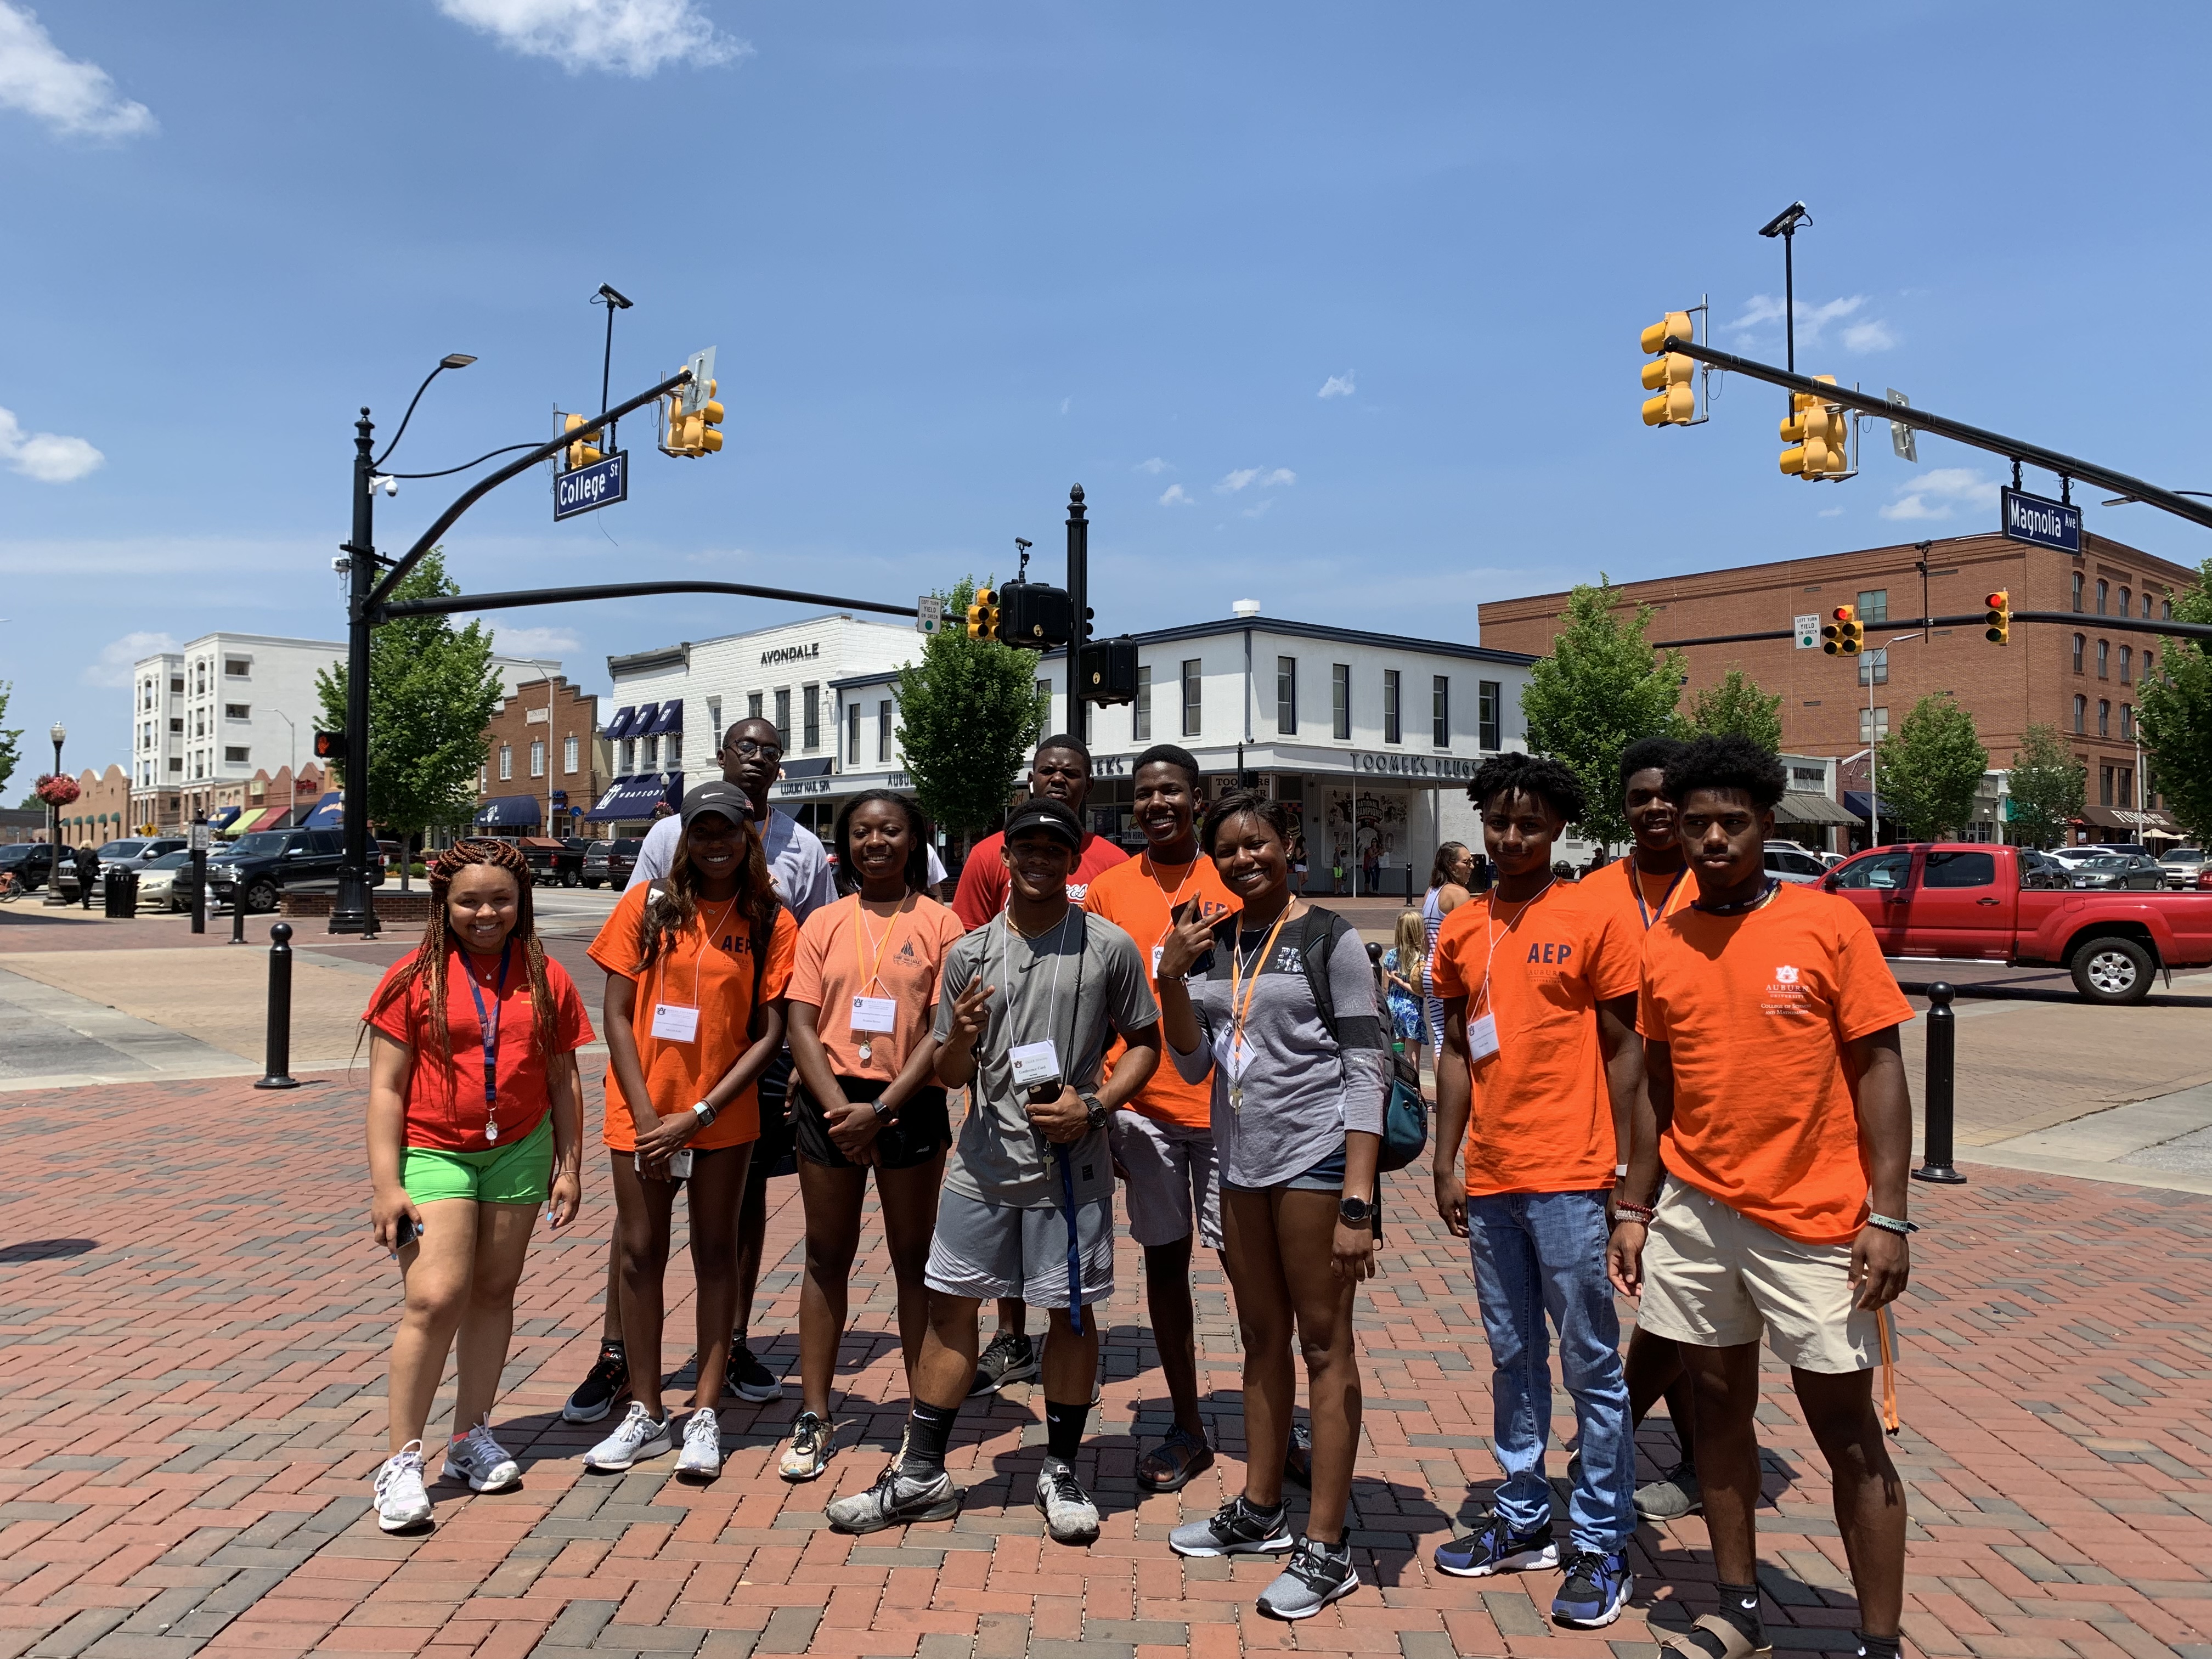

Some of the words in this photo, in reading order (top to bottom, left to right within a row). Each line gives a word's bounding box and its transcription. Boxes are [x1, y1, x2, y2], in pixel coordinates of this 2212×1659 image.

[560, 472, 605, 505] College
[610, 463, 618, 478] St
[2011, 498, 2061, 538] Magnolia
[2064, 513, 2076, 529] Ave
[760, 642, 819, 664] AVONDALE
[1350, 753, 1427, 773] TOOMER'S
[781, 782, 803, 795] LUXURY
[804, 781, 817, 793] NAIL
[819, 780, 830, 792] SPA
[1356, 807, 1382, 819] HAMPIONS
[1527, 943, 1571, 964] AEP
